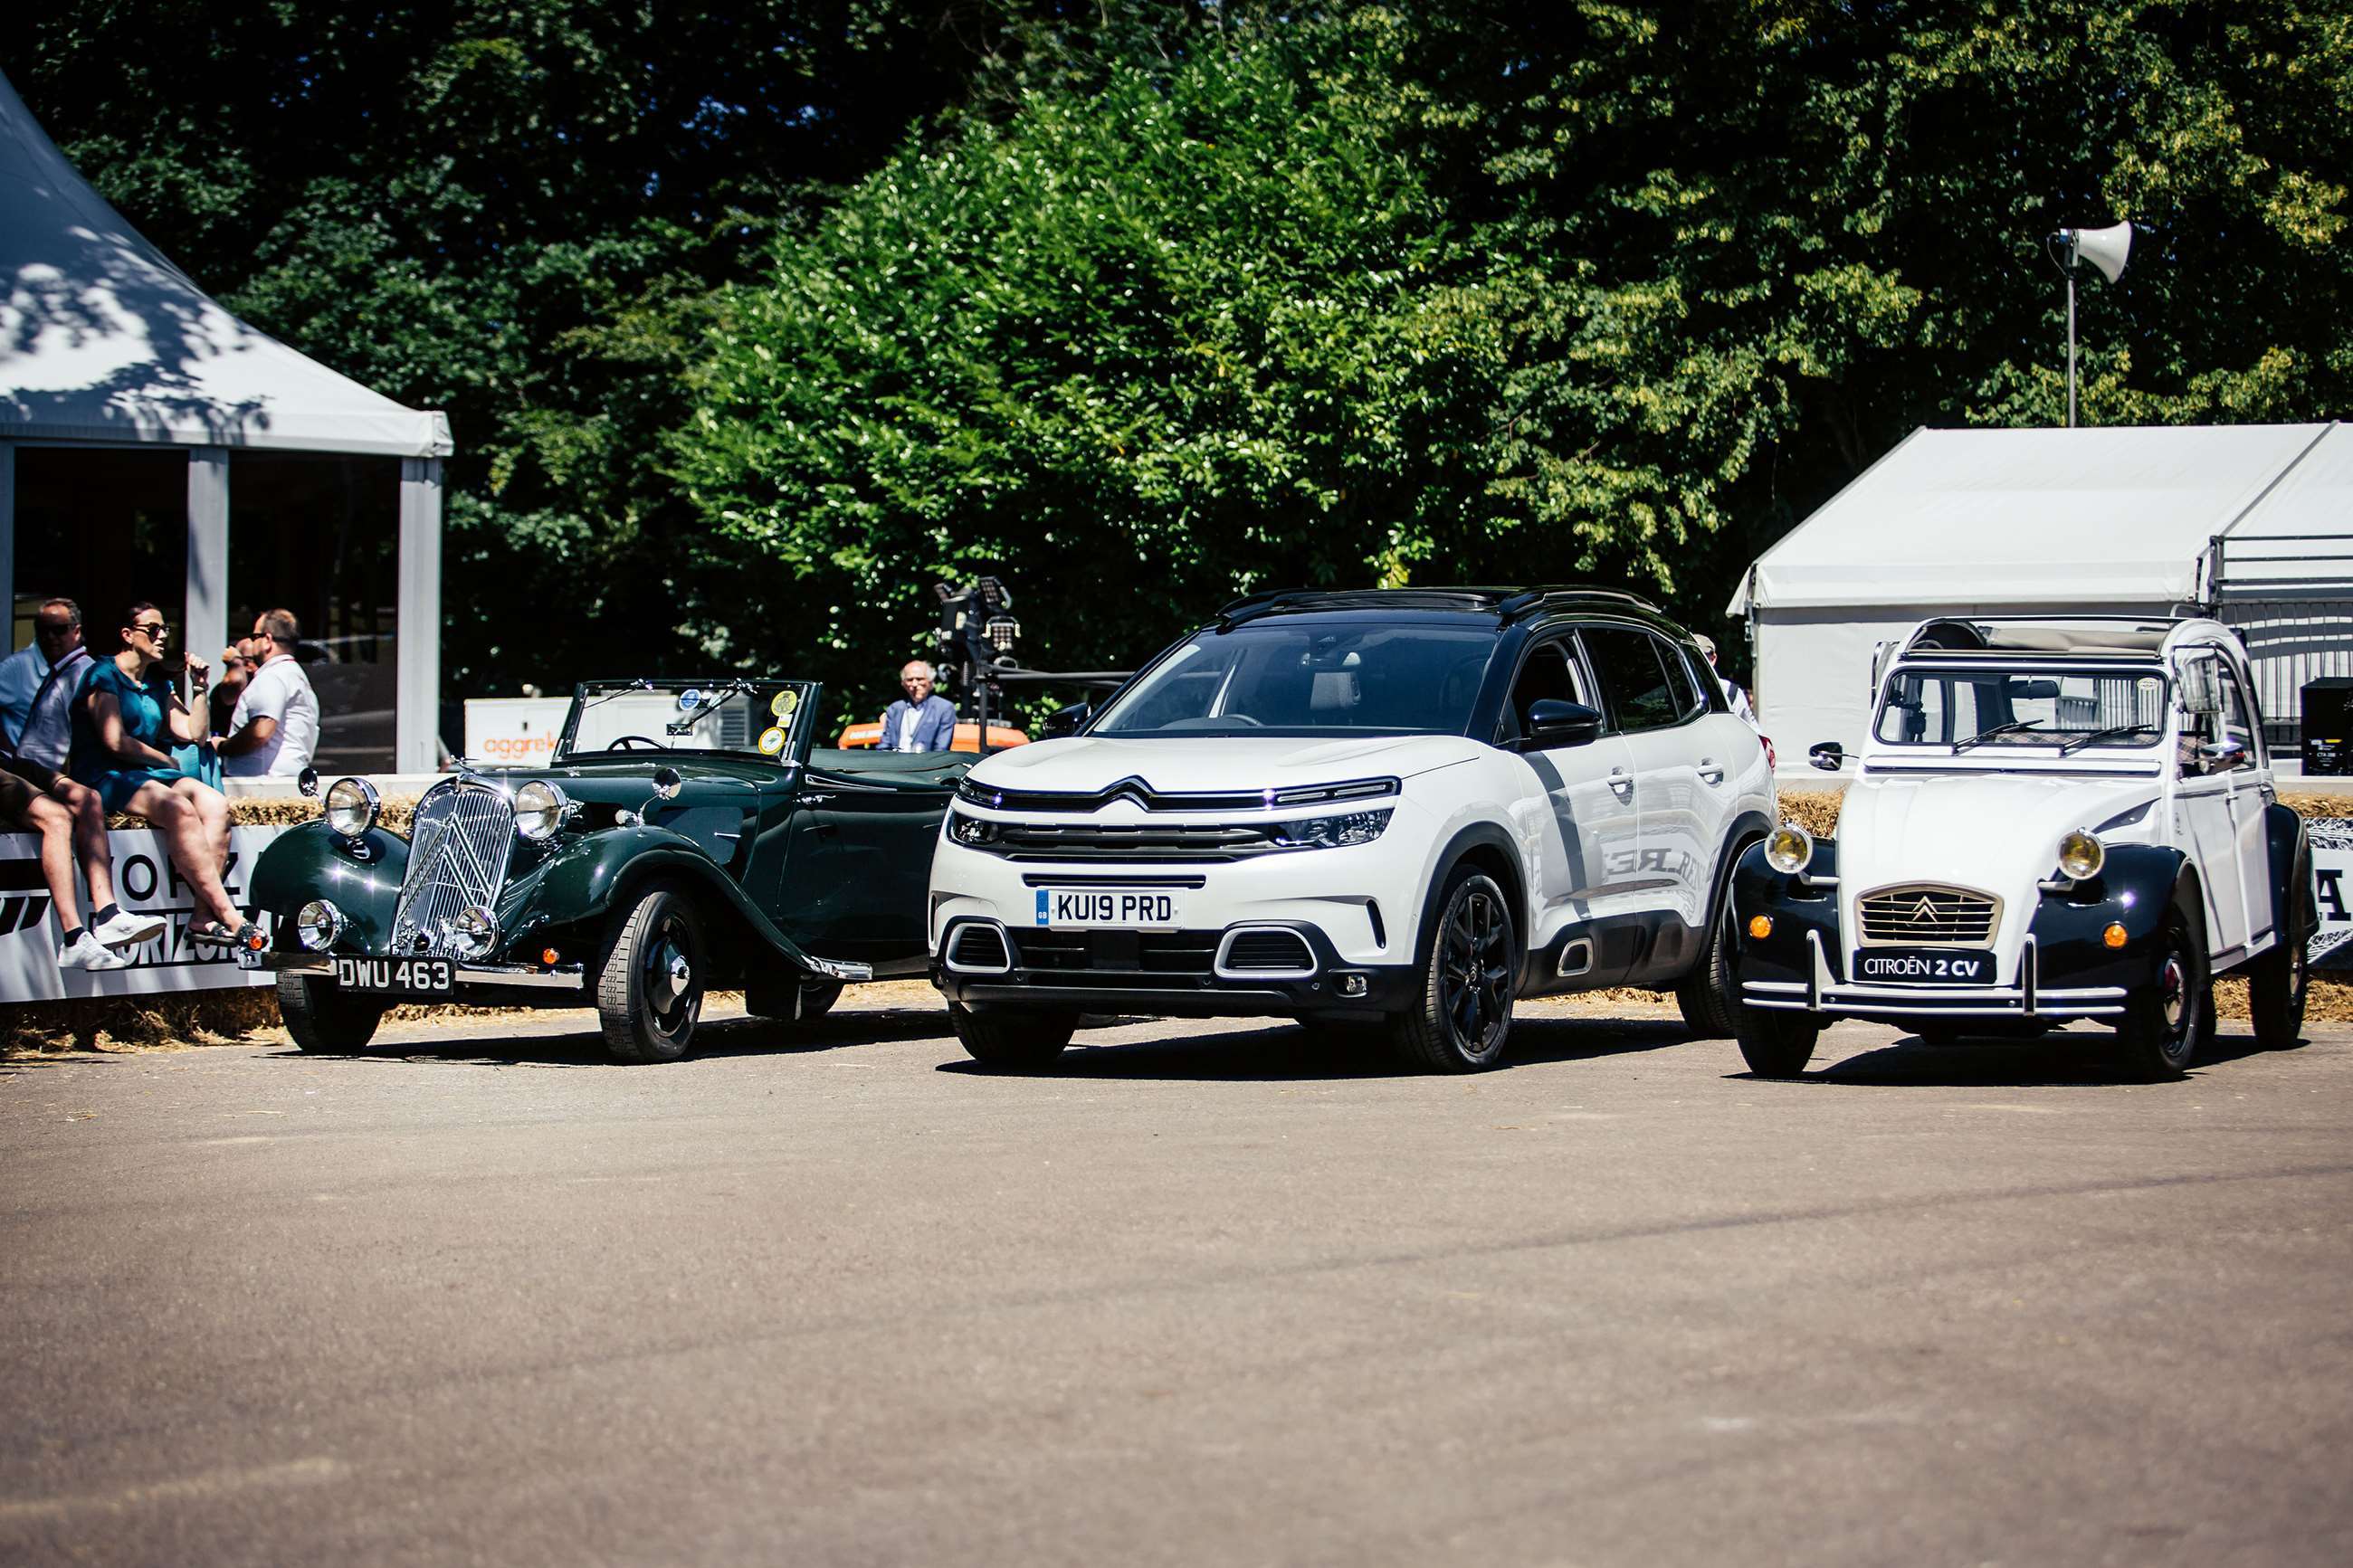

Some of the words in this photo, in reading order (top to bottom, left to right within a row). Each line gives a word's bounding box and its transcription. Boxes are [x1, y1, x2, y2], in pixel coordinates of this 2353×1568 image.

[1038, 911, 1047, 919] GB
[1058, 895, 1113, 921] KU19
[1121, 895, 1171, 921] PRD
[338, 959, 389, 988] DWU
[395, 961, 450, 990] 463
[1864, 955, 1930, 974] CITROËN
[1934, 959, 1948, 975] 2
[1951, 960, 1979, 976] CV
